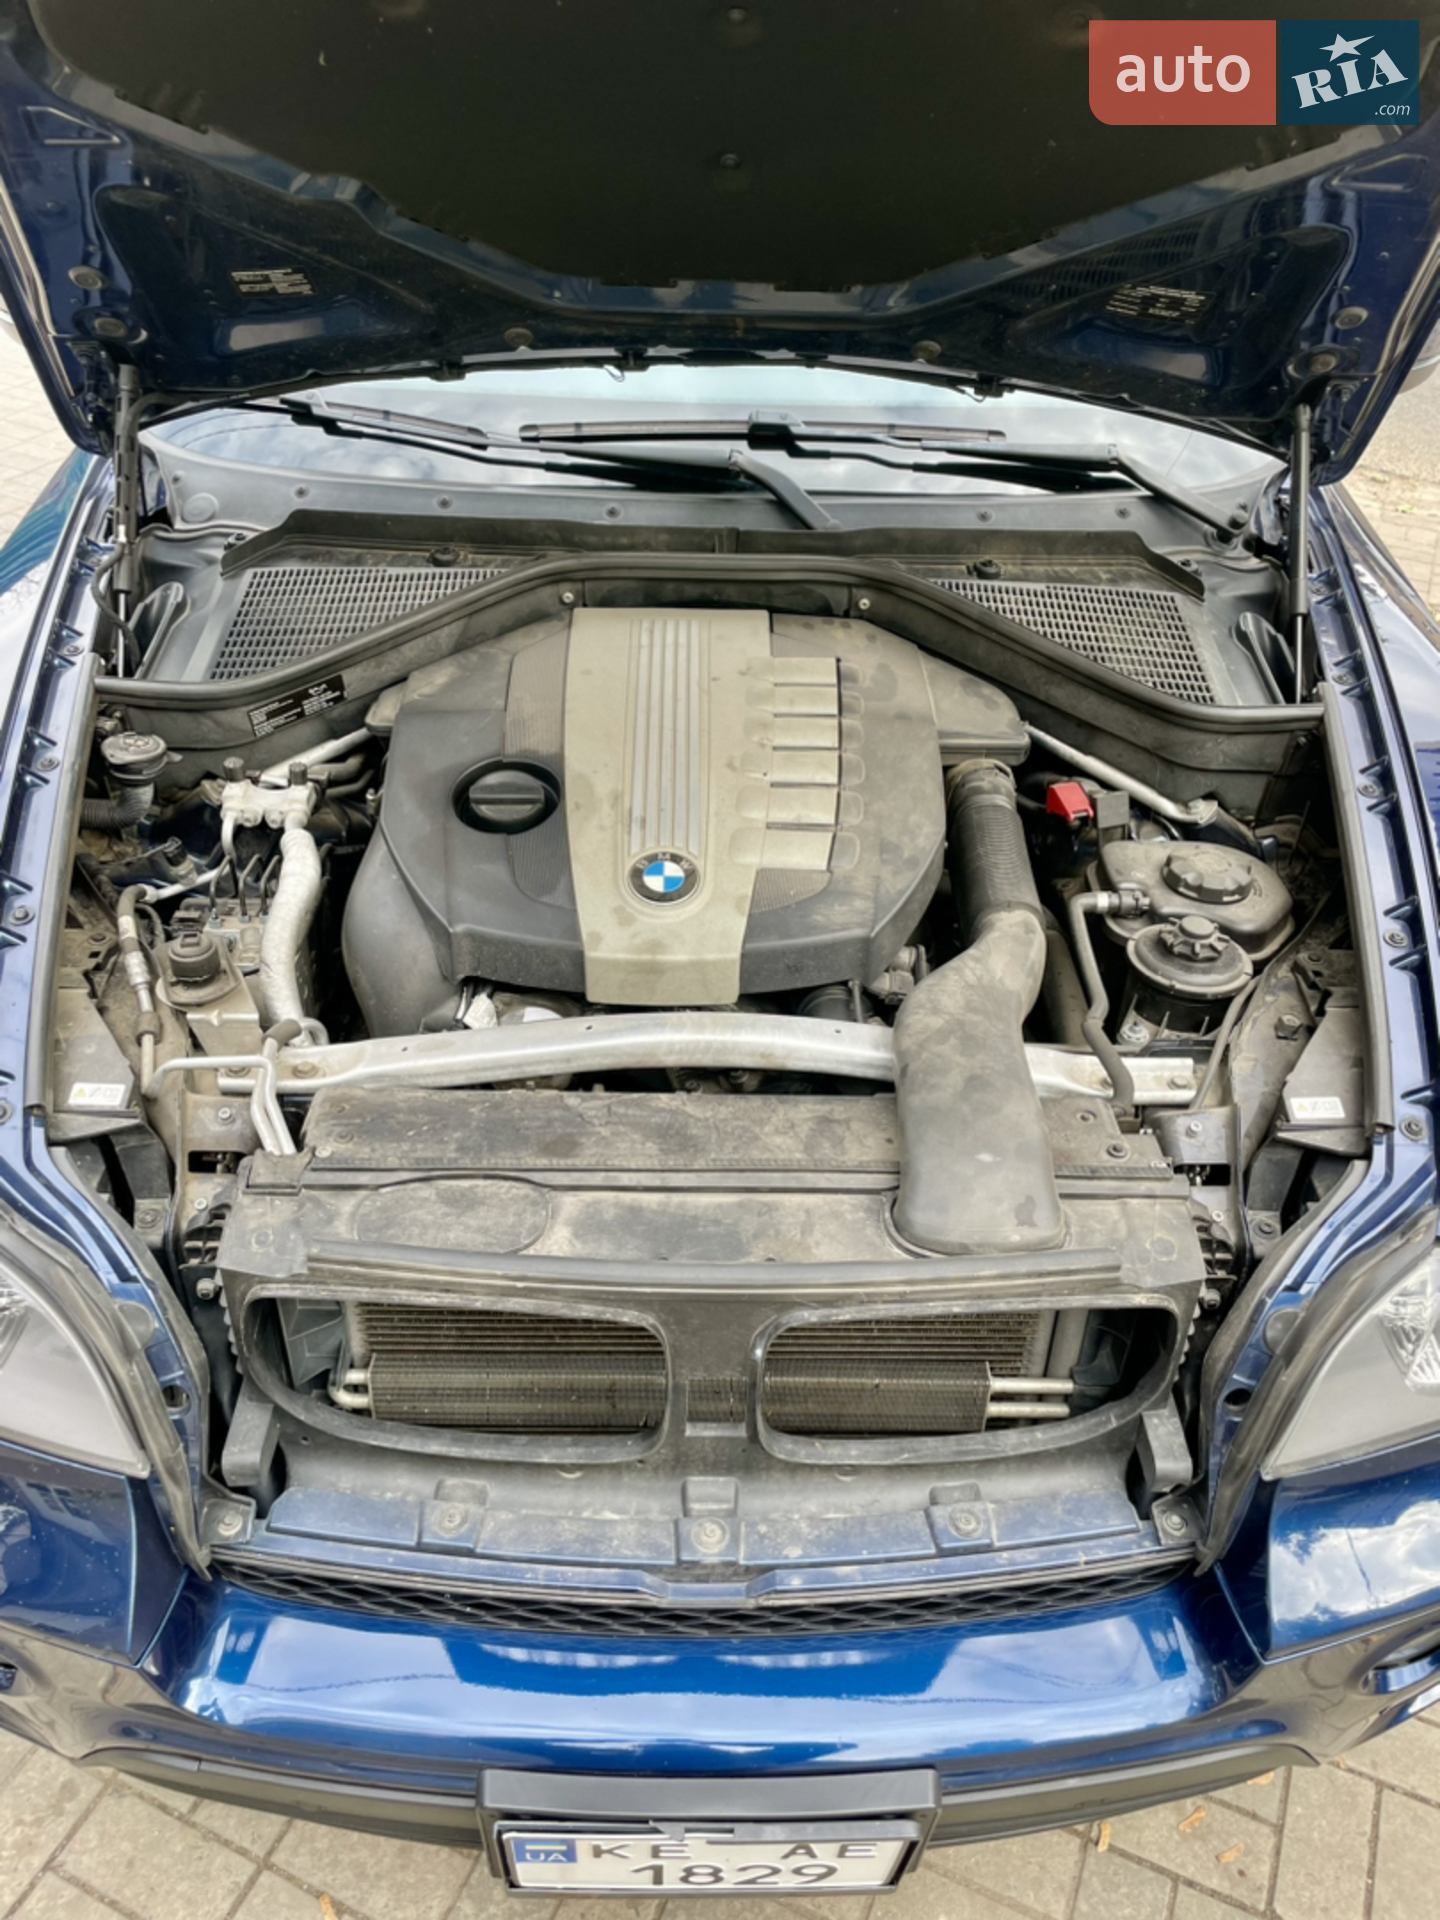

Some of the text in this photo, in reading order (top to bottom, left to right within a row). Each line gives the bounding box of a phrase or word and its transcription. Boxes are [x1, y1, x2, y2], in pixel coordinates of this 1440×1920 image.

[635, 852, 693, 870] BMW
[525, 1852, 568, 1862] UA
[592, 1843, 877, 1859] KE AE
[630, 1863, 839, 1886] 1829
